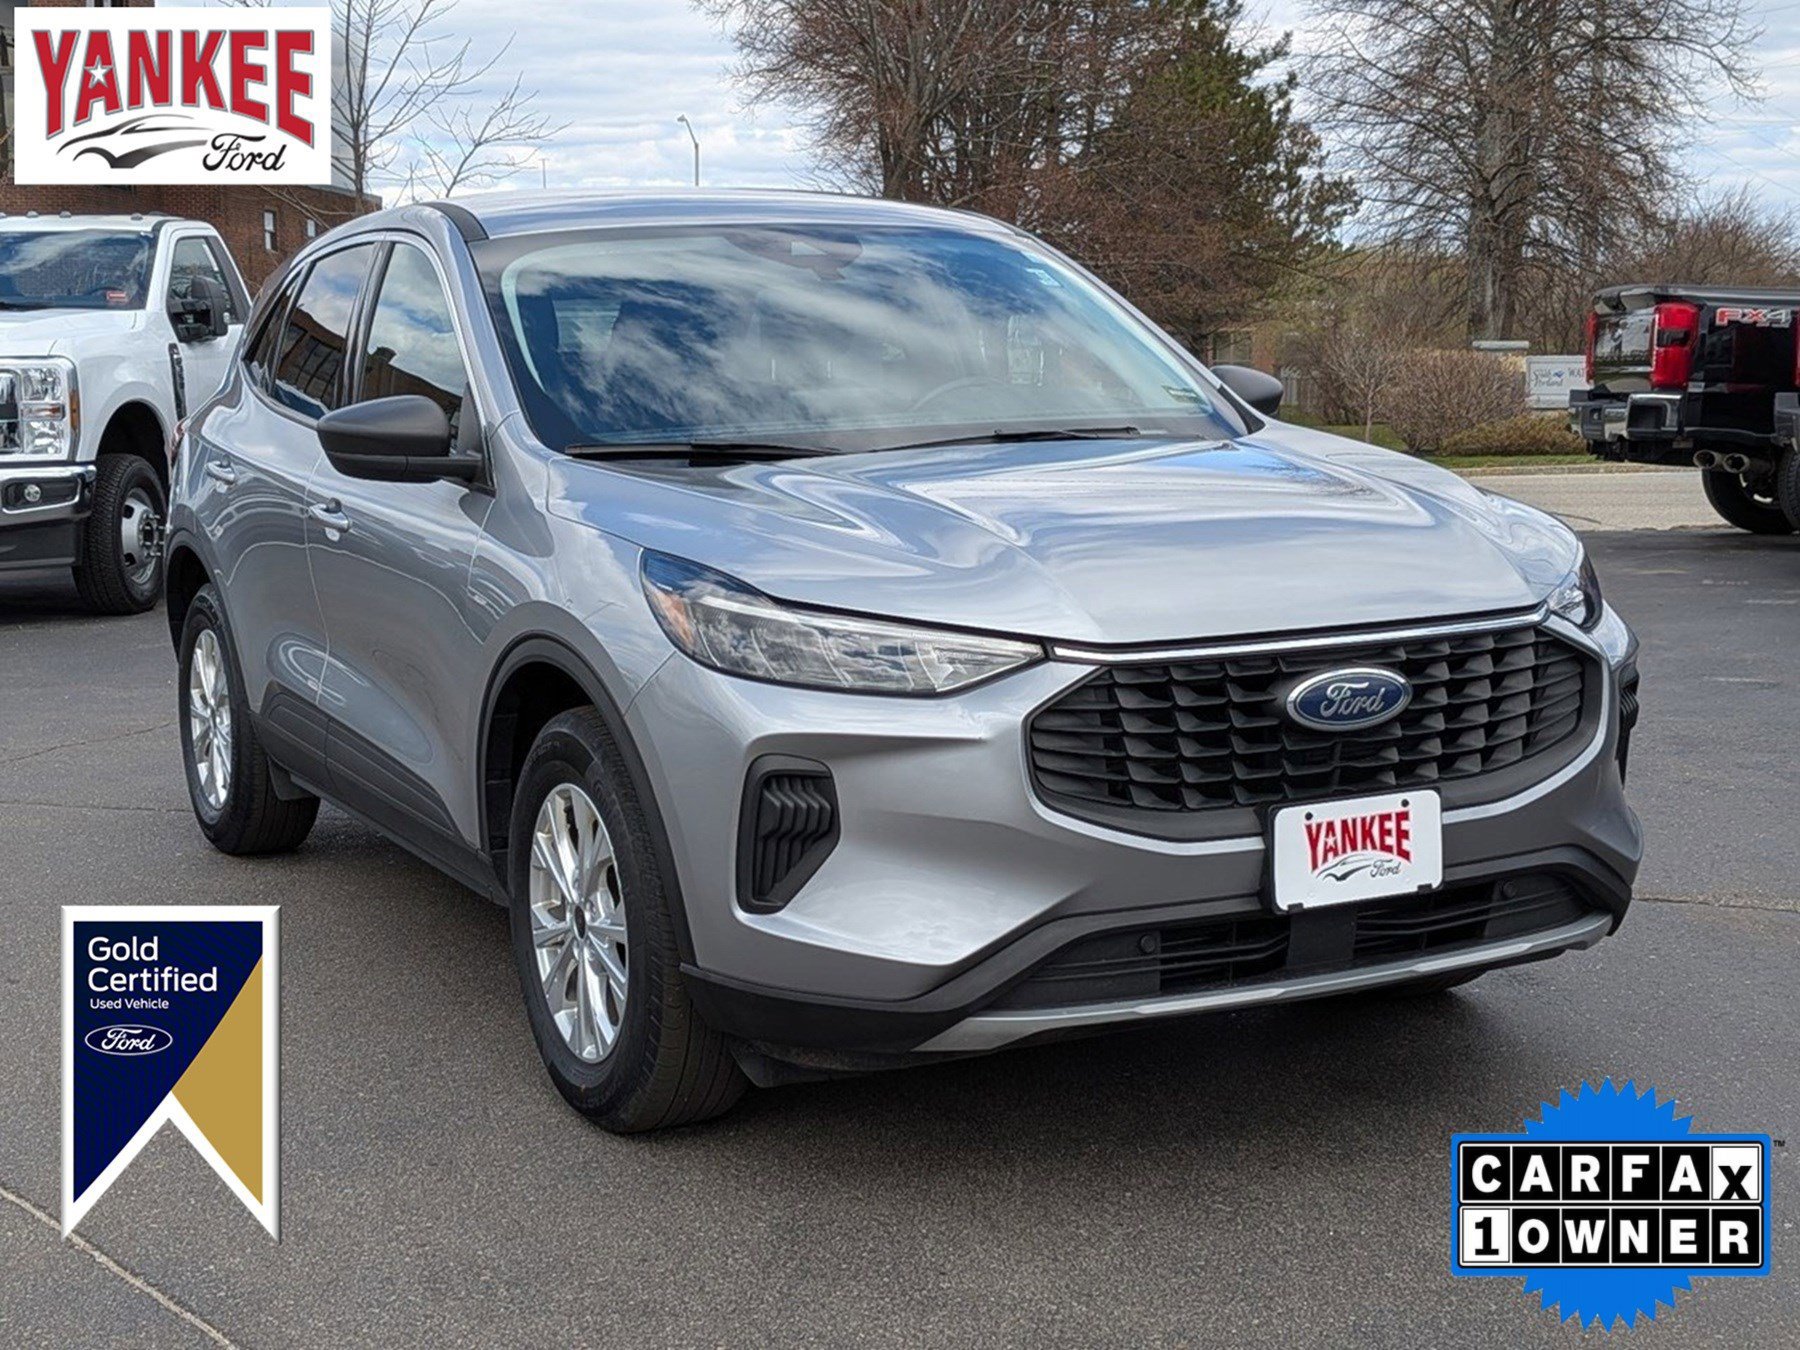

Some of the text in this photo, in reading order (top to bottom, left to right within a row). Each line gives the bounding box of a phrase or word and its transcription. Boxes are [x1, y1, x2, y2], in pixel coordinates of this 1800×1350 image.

[1715, 307, 1792, 328] FX4
[1320, 682, 1387, 718] Ford
[1304, 810, 1412, 873] YANKEE
[1369, 858, 1402, 878] Ford
